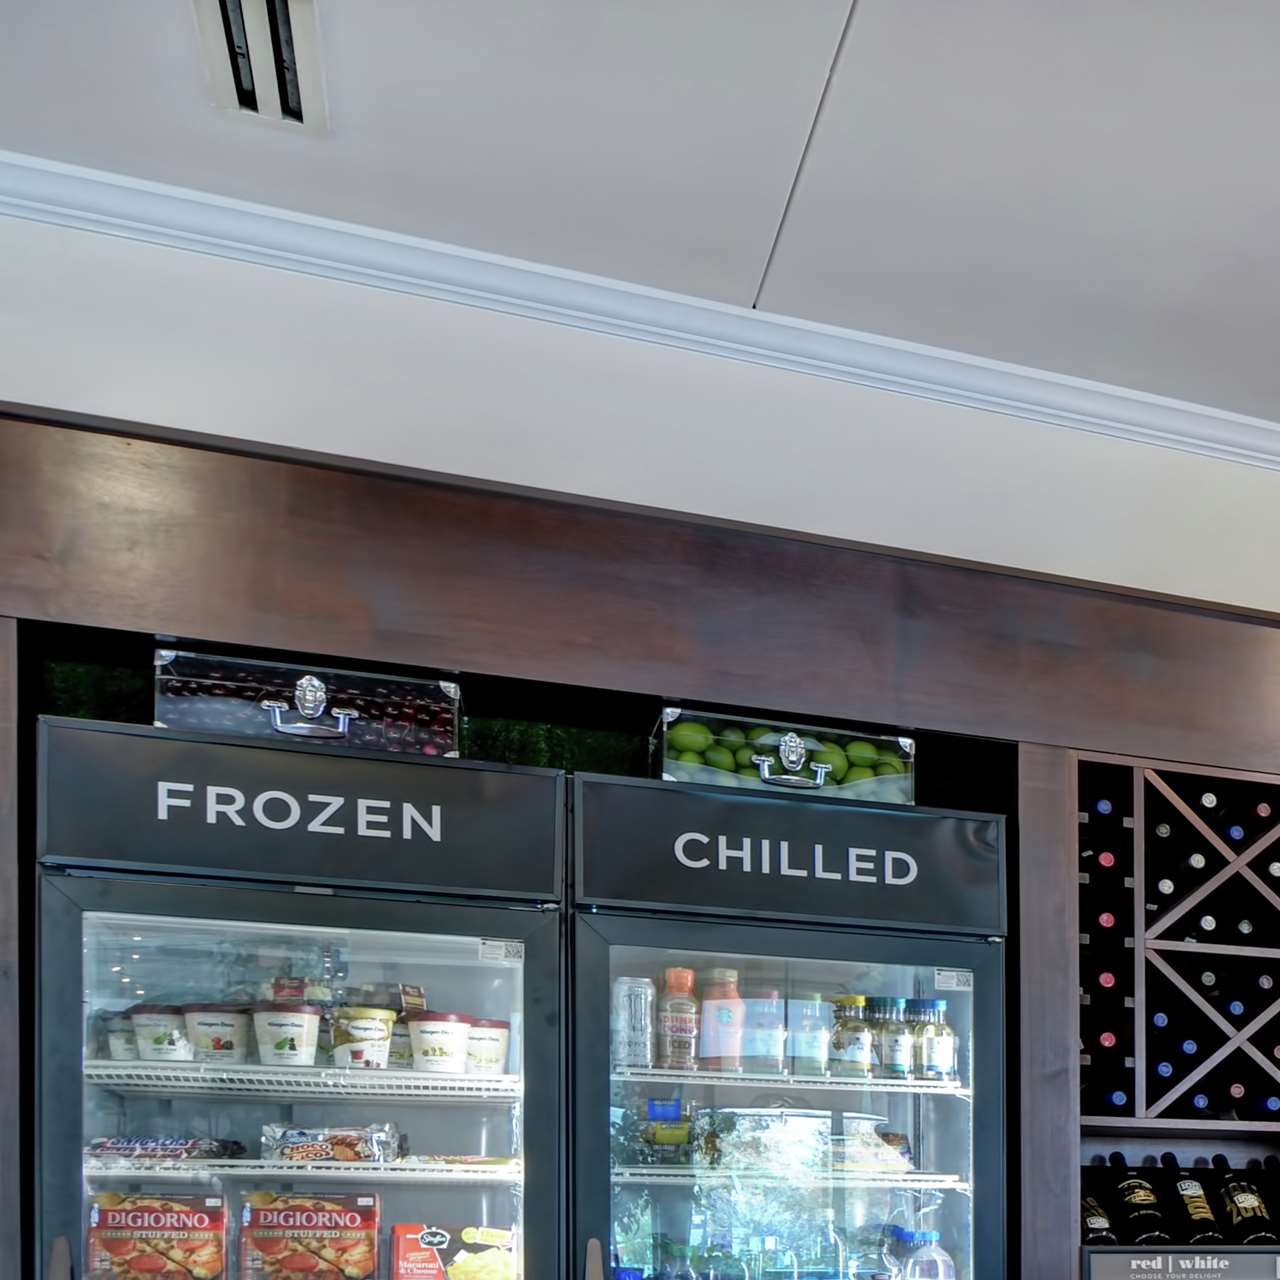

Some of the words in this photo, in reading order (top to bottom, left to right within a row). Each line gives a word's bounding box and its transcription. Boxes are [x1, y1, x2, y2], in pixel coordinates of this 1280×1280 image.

[155, 779, 444, 842] FROZEN
[673, 831, 919, 886] CHILLED
[133, 1231, 188, 1239] STUFFED
[285, 1230, 340, 1238] STUFFED
[1130, 1256, 1162, 1269] red
[1179, 1256, 1230, 1269] white
